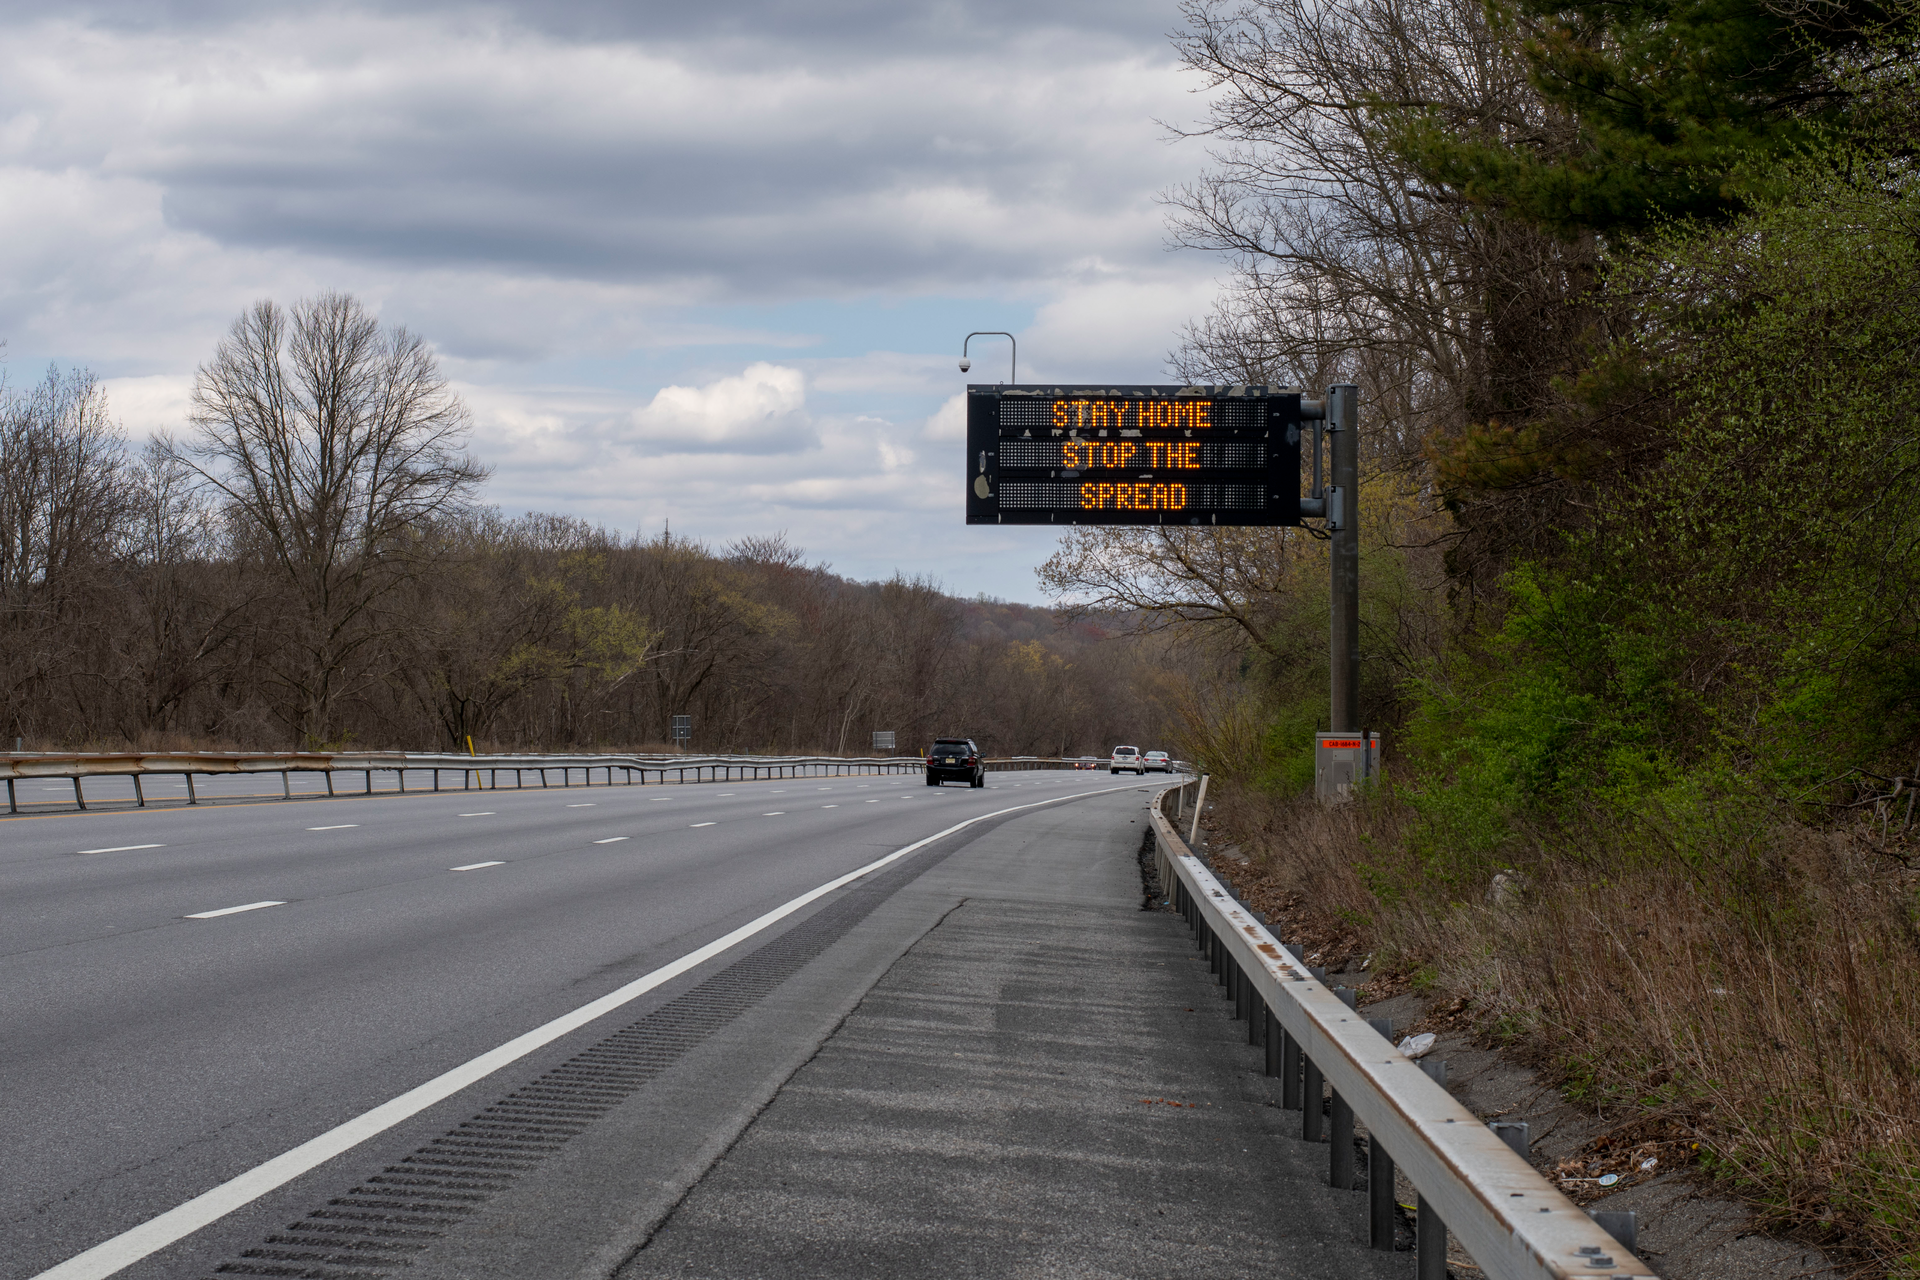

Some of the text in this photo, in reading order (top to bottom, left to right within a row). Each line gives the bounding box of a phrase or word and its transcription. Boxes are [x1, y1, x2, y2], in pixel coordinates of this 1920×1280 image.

[1052, 400, 1212, 428] STAY HOME
[1062, 441, 1201, 469] STOP THE
[1080, 482, 1186, 510] SPREAD
